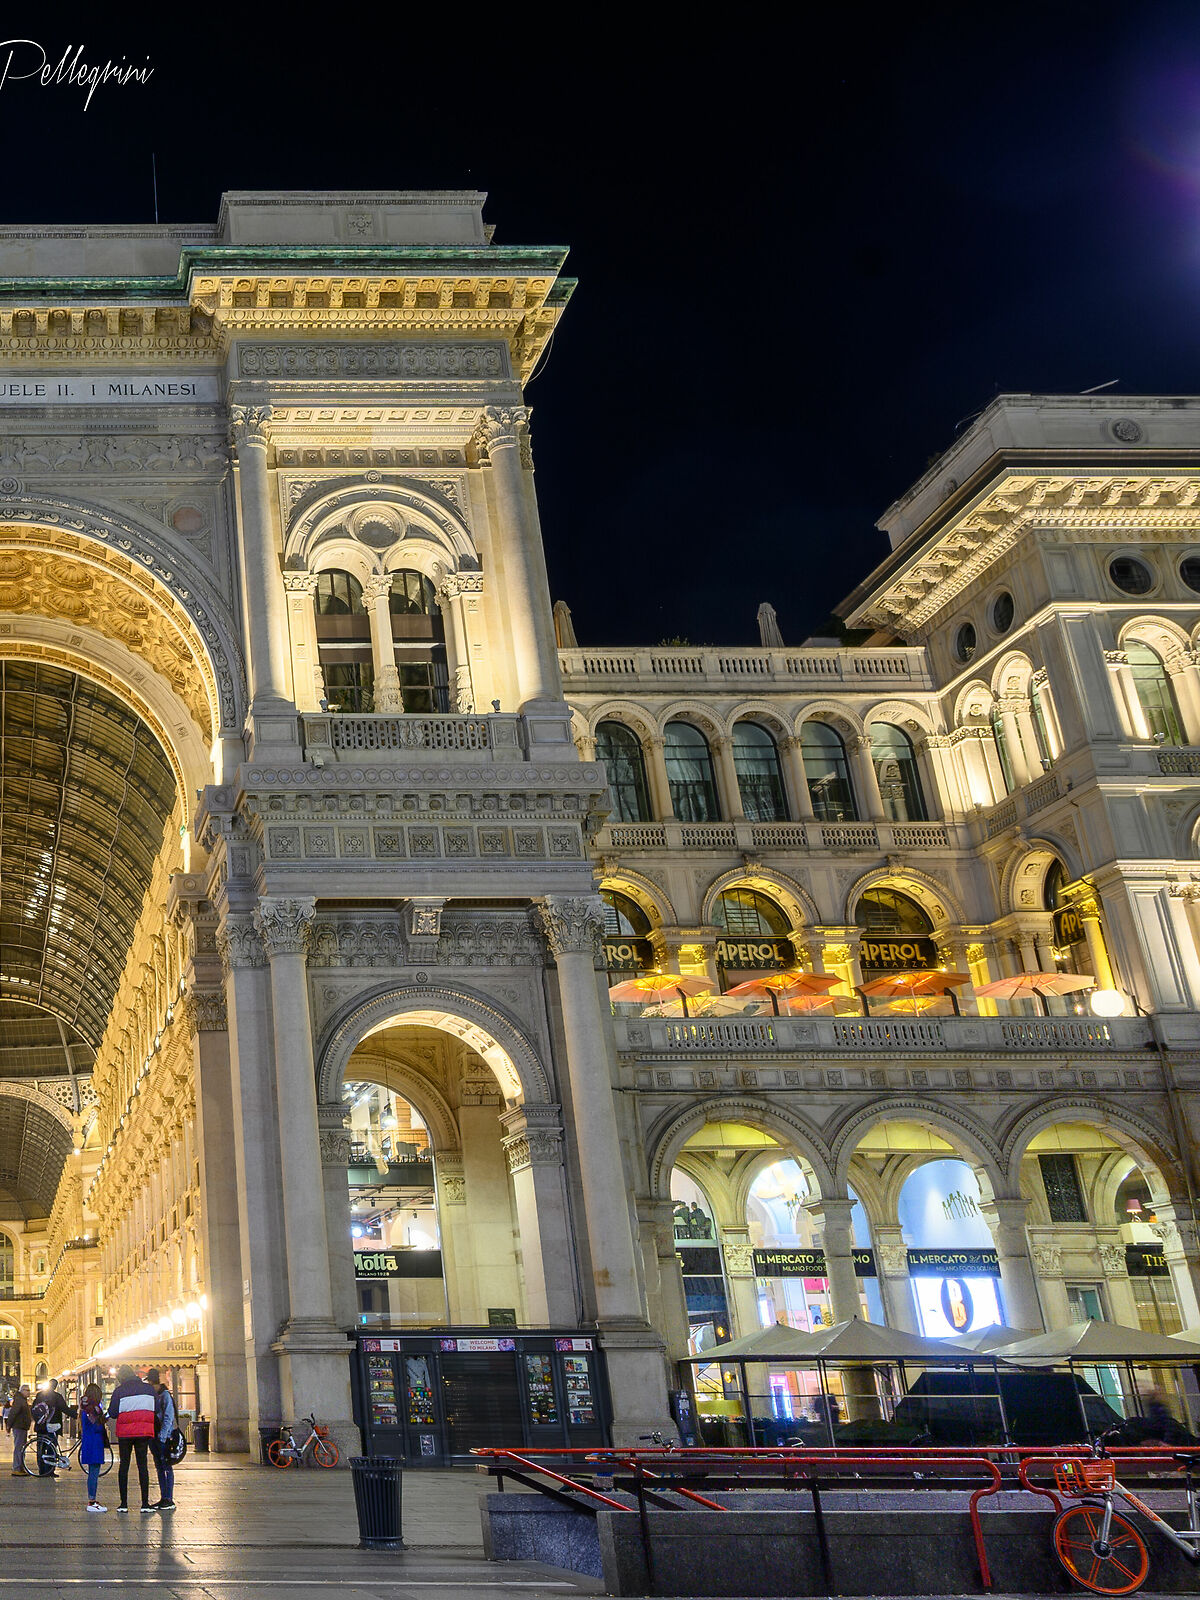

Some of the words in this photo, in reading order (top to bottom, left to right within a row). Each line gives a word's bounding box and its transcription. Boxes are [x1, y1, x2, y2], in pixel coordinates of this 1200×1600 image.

[91, 384, 97, 396] I
[107, 383, 197, 396] MILANESI
[715, 940, 785, 961] APEROL
[858, 940, 927, 961] APEROL
[354, 1253, 398, 1271] Motta
[756, 1255, 765, 1264] IL
[766, 1254, 814, 1264] MERCATO
[909, 1255, 919, 1264] IL
[920, 1254, 968, 1264] MERCATO
